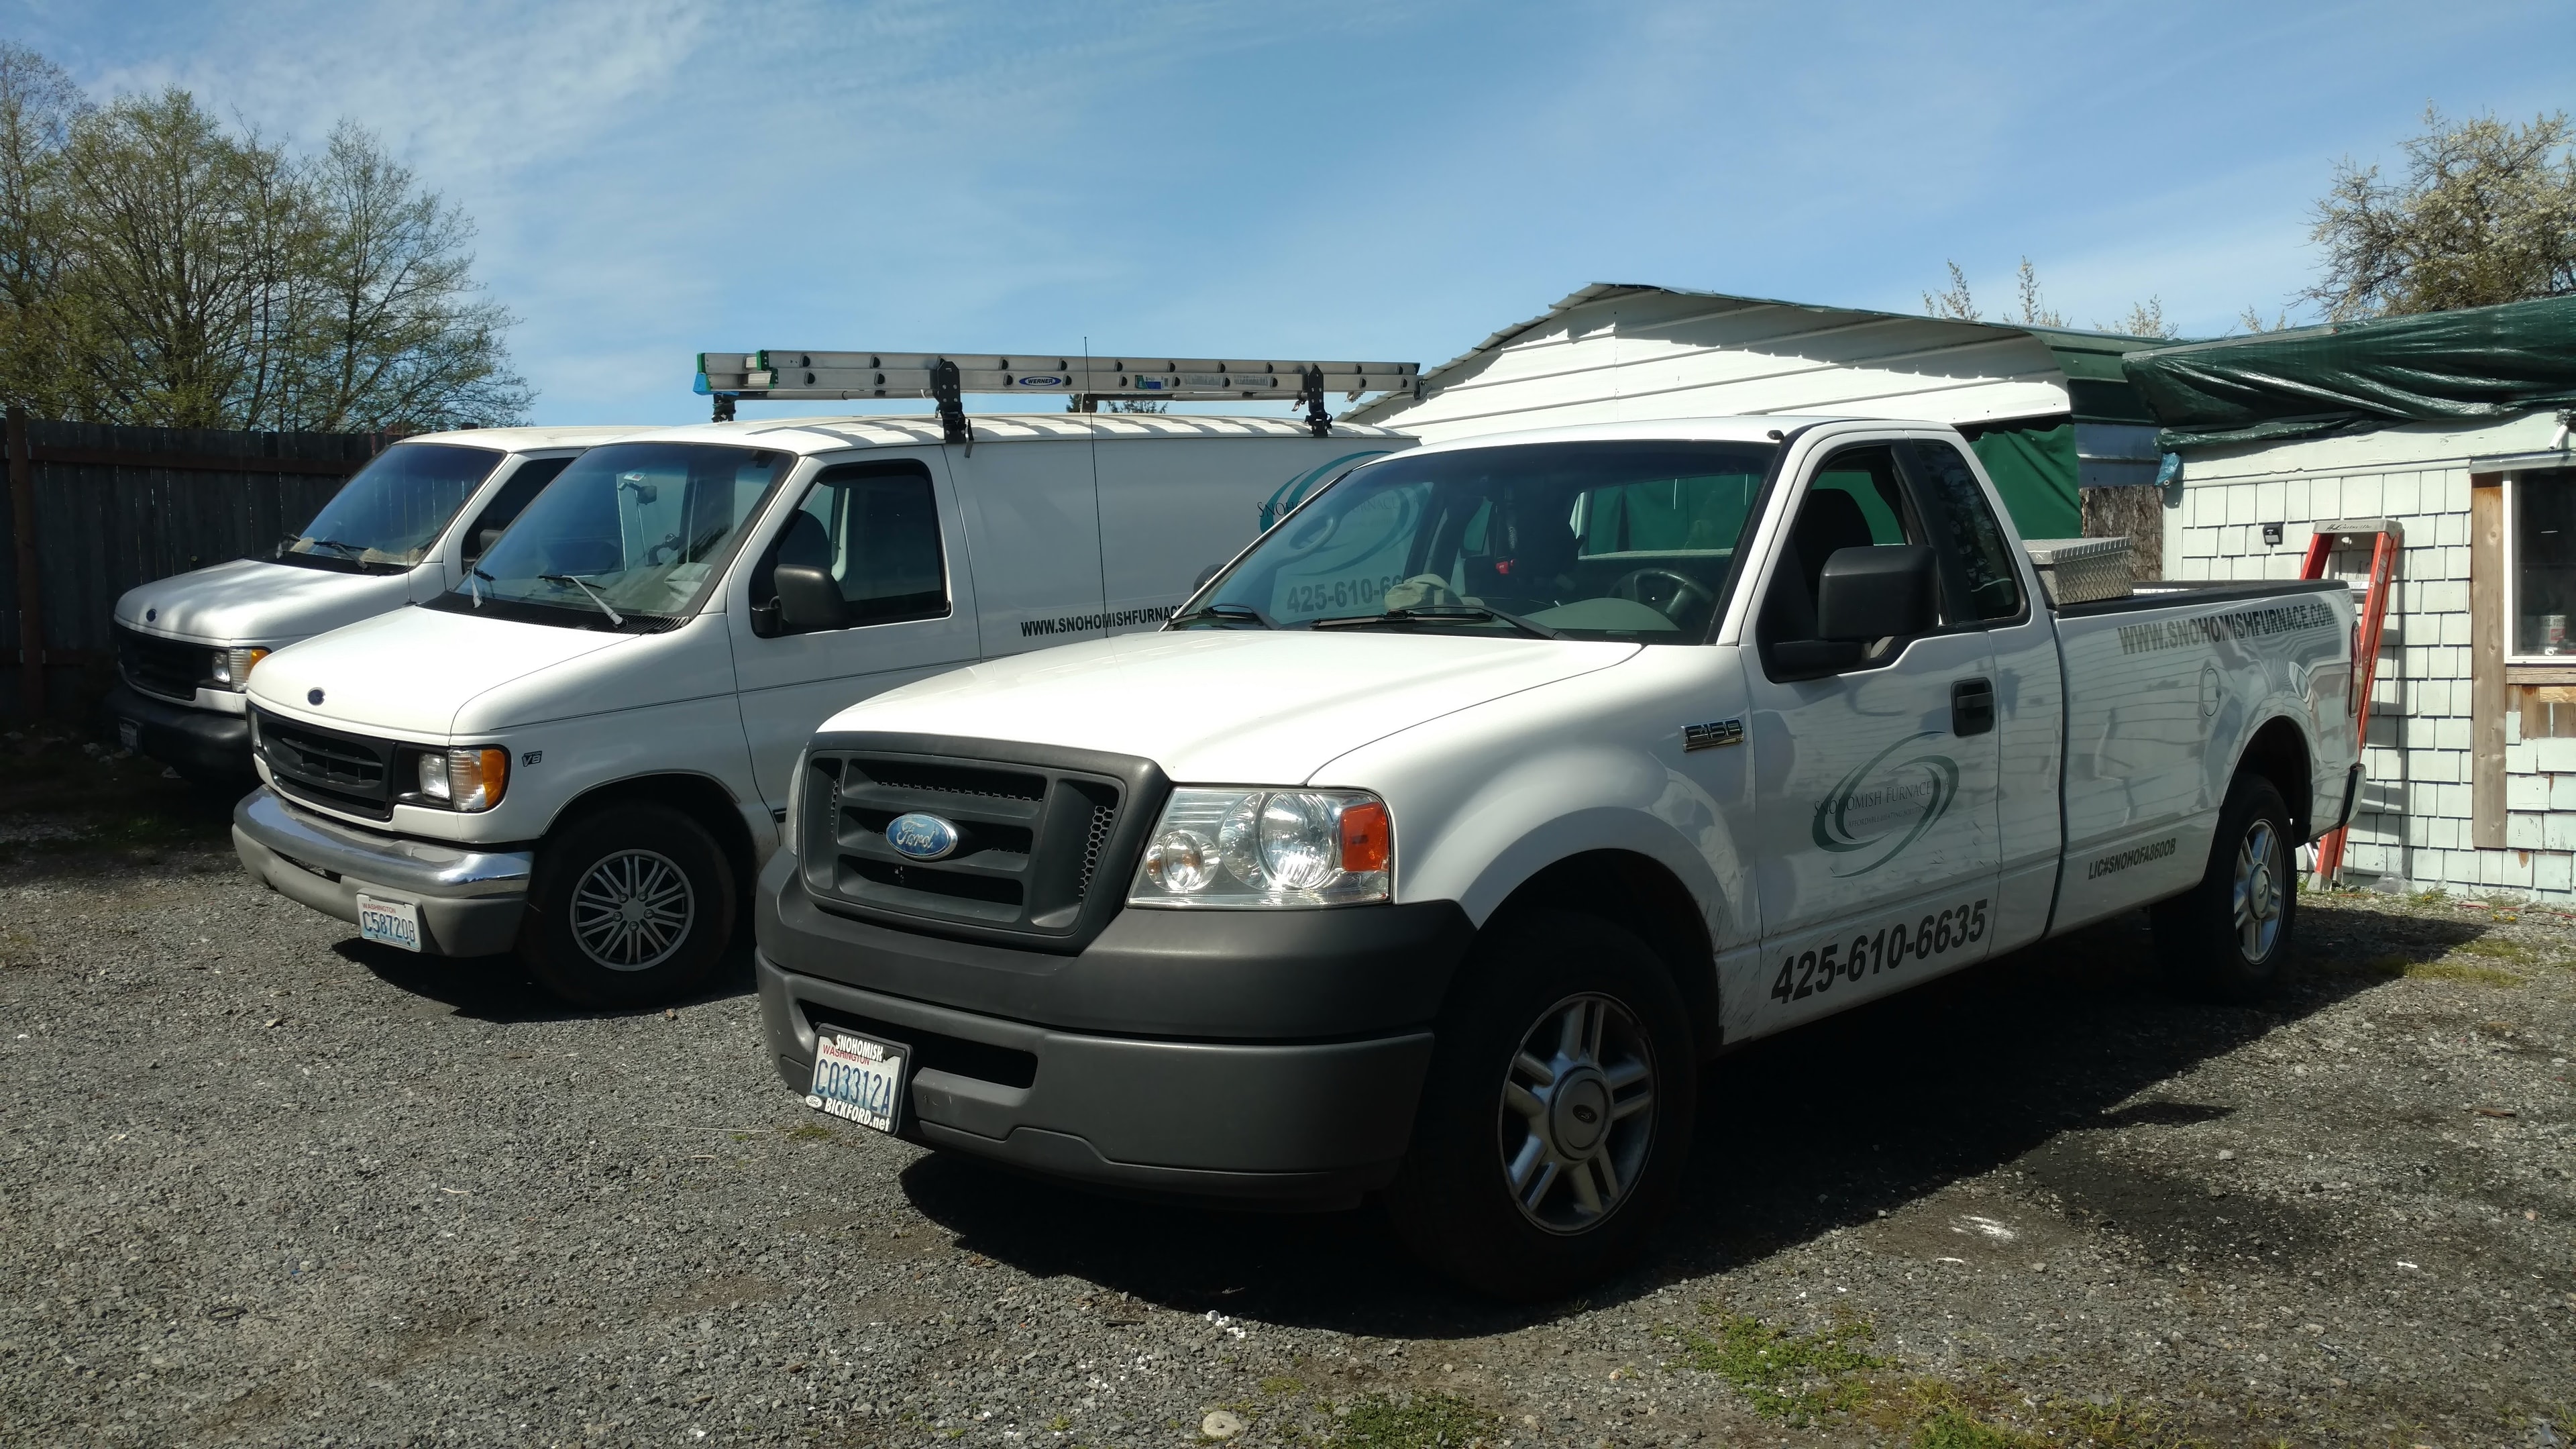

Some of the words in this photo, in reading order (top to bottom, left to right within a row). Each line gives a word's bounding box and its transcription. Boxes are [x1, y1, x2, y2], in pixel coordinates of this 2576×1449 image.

[1020, 604, 1183, 637] WWW.SNOHOMISHFURNAC
[2117, 602, 2337, 655] WWW.SNOHOMISHFURNACE.COM
[523, 755, 541, 767] V8
[1886, 780, 1932, 804] FURNACE
[896, 820, 936, 849] Ford
[362, 903, 396, 914] WASHINGTON
[362, 911, 415, 943] C58720B
[1771, 898, 1988, 1004] 425-610-6635
[835, 1034, 884, 1062] SNOHOMISH
[815, 1058, 892, 1116] C03312A
[824, 1097, 890, 1132] BICKFORD.net
